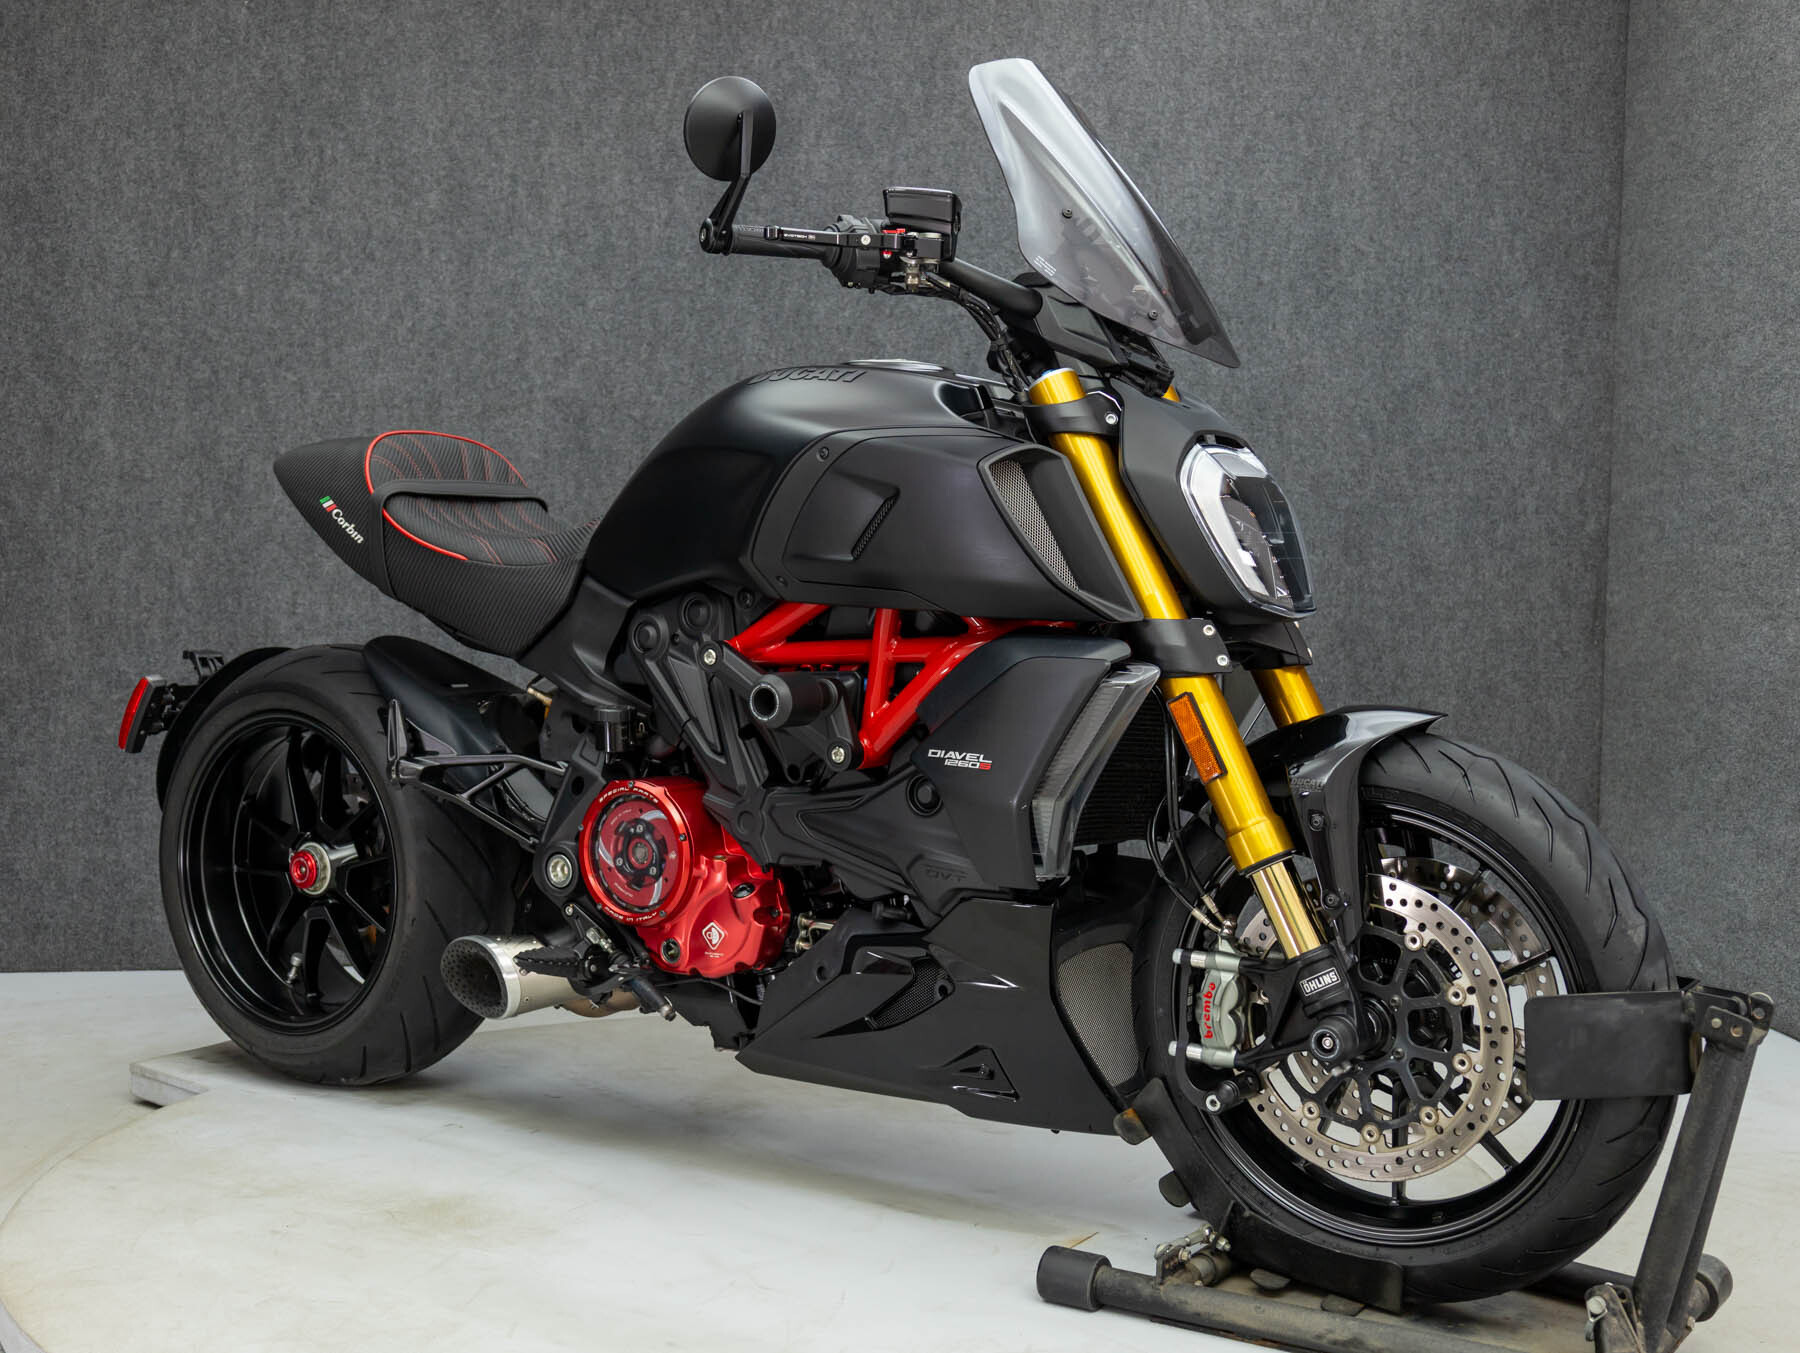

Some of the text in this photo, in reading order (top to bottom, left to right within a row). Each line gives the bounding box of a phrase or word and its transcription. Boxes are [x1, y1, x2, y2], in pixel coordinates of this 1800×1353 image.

[332, 508, 364, 544] Corbin
[928, 749, 992, 763] DIAVEL
[1203, 982, 1216, 1039] brembo
